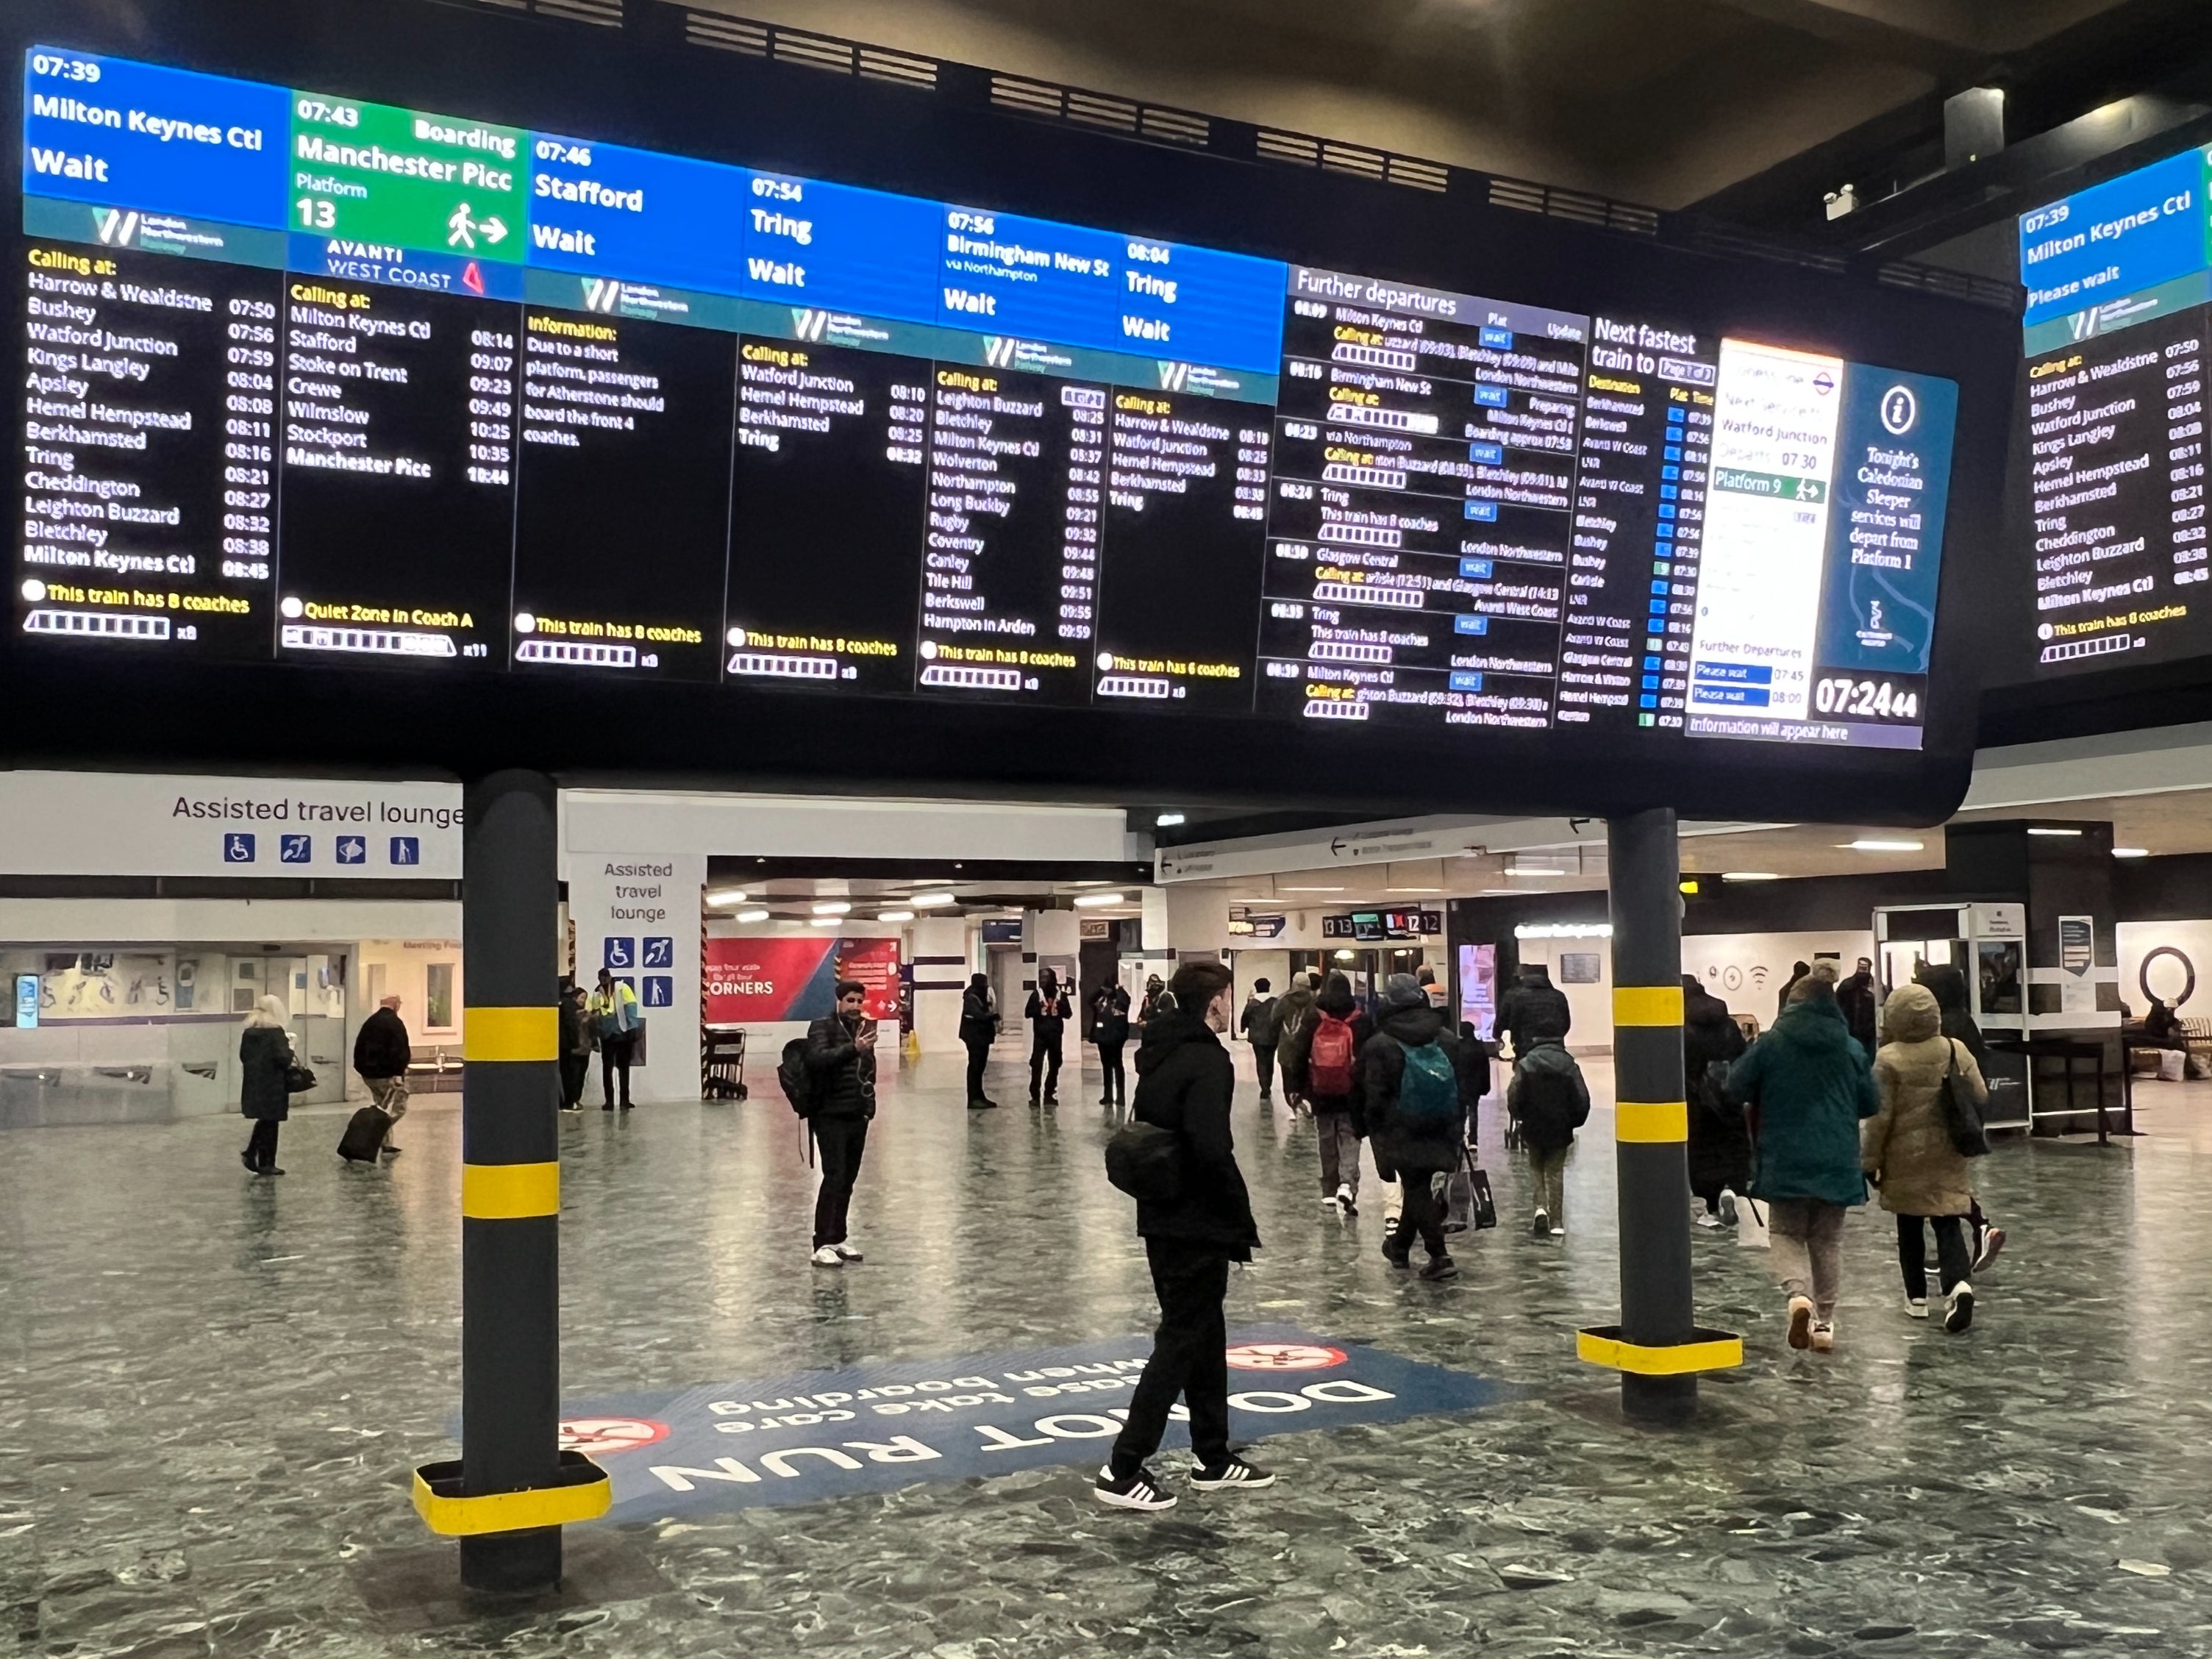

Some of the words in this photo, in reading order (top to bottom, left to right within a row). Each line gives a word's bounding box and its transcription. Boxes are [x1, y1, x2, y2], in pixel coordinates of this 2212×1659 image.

[33, 54, 100, 82] 07:39
[33, 93, 121, 129] Milton
[128, 110, 222, 144] Keynes
[226, 126, 262, 151] Ctl
[298, 99, 358, 127] 07:43
[414, 118, 516, 159] Boarding
[31, 147, 108, 182] Wait
[298, 135, 457, 182] Manchester
[463, 162, 512, 191] Picc
[535, 140, 591, 166] 07:46
[296, 172, 367, 198] Platform
[535, 174, 643, 212] Stafford
[752, 178, 802, 202] 07:54
[296, 198, 335, 229] 13
[948, 211, 994, 235] 07:56
[2026, 205, 2069, 234] 07:39
[532, 224, 596, 256] Wait
[750, 209, 813, 246] Tring
[2027, 232, 2086, 265] Milton
[2090, 207, 2159, 243] Keynes
[2163, 190, 2191, 215] Ctl
[29, 249, 90, 276] Calling
[94, 260, 116, 276] at:
[327, 240, 402, 263] AVANTI
[947, 234, 1051, 267] Birmingham
[1055, 251, 1091, 274] New
[1093, 259, 1110, 277] St
[1127, 243, 1169, 264] 08:04
[327, 259, 382, 279] WEST
[388, 267, 451, 288] COAST
[748, 257, 805, 287] Wait
[946, 260, 962, 270] via
[964, 260, 1038, 282] Northampton
[29, 271, 98, 296] Harrow
[101, 282, 117, 299] &
[120, 284, 213, 312] Wealdstne
[290, 284, 347, 310] Calling
[349, 294, 371, 309] at:
[1126, 271, 1177, 304] Tring
[1298, 269, 1363, 299] Further
[1366, 280, 1456, 315] departures
[2029, 279, 2080, 308] Please
[2082, 265, 2120, 288] wait
[28, 296, 96, 326] Bushey
[229, 299, 275, 319] 07:50
[944, 288, 996, 315] Wait
[228, 323, 274, 343] 07:56
[291, 305, 346, 328] Milton
[349, 313, 406, 337] Keynes
[408, 321, 431, 339] Ctl
[528, 316, 617, 341] Information:
[1122, 315, 1170, 341] Wait
[27, 322, 102, 347] Watford
[104, 331, 178, 356] Junction
[290, 329, 356, 353] Stafford
[1595, 317, 1636, 345] Next
[1638, 324, 1697, 355] fastest
[2165, 338, 2199, 359] 07:50
[27, 347, 77, 373] Kings
[82, 353, 150, 382] Langley
[227, 346, 274, 367] 07:59
[288, 353, 336, 374] Stoke
[339, 362, 361, 377] on
[364, 361, 407, 383] Trent
[1592, 345, 1633, 371] train
[1636, 352, 1655, 374] to
[26, 371, 90, 399] Apsley
[227, 371, 273, 390] 08:04
[288, 377, 342, 399] Crewe
[2030, 374, 2076, 398] Harrow
[2077, 370, 2088, 385] &
[2090, 352, 2159, 380] Wealdstne
[27, 396, 87, 419] Hemel
[90, 403, 191, 430] Hempstead
[288, 400, 369, 425] Wilmslow
[2030, 395, 2076, 418] Bushey
[2031, 413, 2082, 436] Watford
[2082, 398, 2136, 427] Junction
[26, 421, 146, 450] Berkhamsted
[287, 424, 367, 449] Stockport
[1723, 418, 1773, 438] Watford
[1775, 428, 1827, 445] Junction
[25, 446, 74, 472] Tring
[286, 446, 393, 474] Manchester
[932, 452, 997, 471] Wolverton
[1867, 446, 1919, 469] Tonight's
[25, 471, 140, 499] Cheddington
[932, 471, 1016, 495] Northampton
[1715, 470, 1770, 492] Platform
[1773, 478, 1782, 493] 9
[1858, 466, 1923, 490] Caledonian
[26, 496, 104, 520] Leighton
[107, 502, 179, 525] Buzzard
[931, 492, 963, 513] Long
[964, 494, 1010, 518] Buckby
[1866, 488, 1911, 510] Sleeper
[930, 511, 969, 533] Rugby
[1851, 510, 1897, 527] services
[2036, 515, 2067, 533] Tring
[25, 520, 108, 547] Bletchley
[928, 532, 985, 555] Coventry
[1849, 527, 1888, 548] depart
[1890, 531, 1919, 550] from
[2036, 524, 2116, 552] Cheddington
[24, 544, 91, 566] Milton
[93, 549, 165, 574] Keynes
[166, 554, 196, 574] Ctl
[1851, 548, 1900, 568] Platform
[46, 584, 85, 602] This
[88, 588, 129, 605] train
[133, 590, 165, 608] has
[168, 593, 179, 609] 8
[182, 596, 250, 613] coaches
[925, 592, 985, 611] Berkswell
[304, 602, 348, 620] Quiet
[351, 604, 390, 623] Zone
[412, 610, 458, 627] Coach
[460, 613, 474, 628] A
[1699, 640, 1740, 654] Further
[1743, 643, 1802, 658] Departures
[1816, 678, 1891, 716] 07:24
[1690, 717, 1760, 735] Information
[1760, 721, 1780, 736] will
[1780, 725, 1821, 741] appear
[1822, 724, 1848, 741] here
[173, 796, 289, 821] Assisted
[297, 800, 371, 823] travel
[379, 802, 463, 830] lounge
[604, 863, 673, 877] Assisted
[615, 883, 663, 899] travel
[611, 906, 666, 922] lounge
[1423, 916, 1438, 931] 12
[706, 981, 774, 996] ORNERS
[708, 1376, 1000, 1416] boarding
[872, 1392, 1016, 1415] take
[1226, 1380, 1397, 1413] DO
[713, 1409, 856, 1434] care
[649, 1435, 943, 1491] RUN
